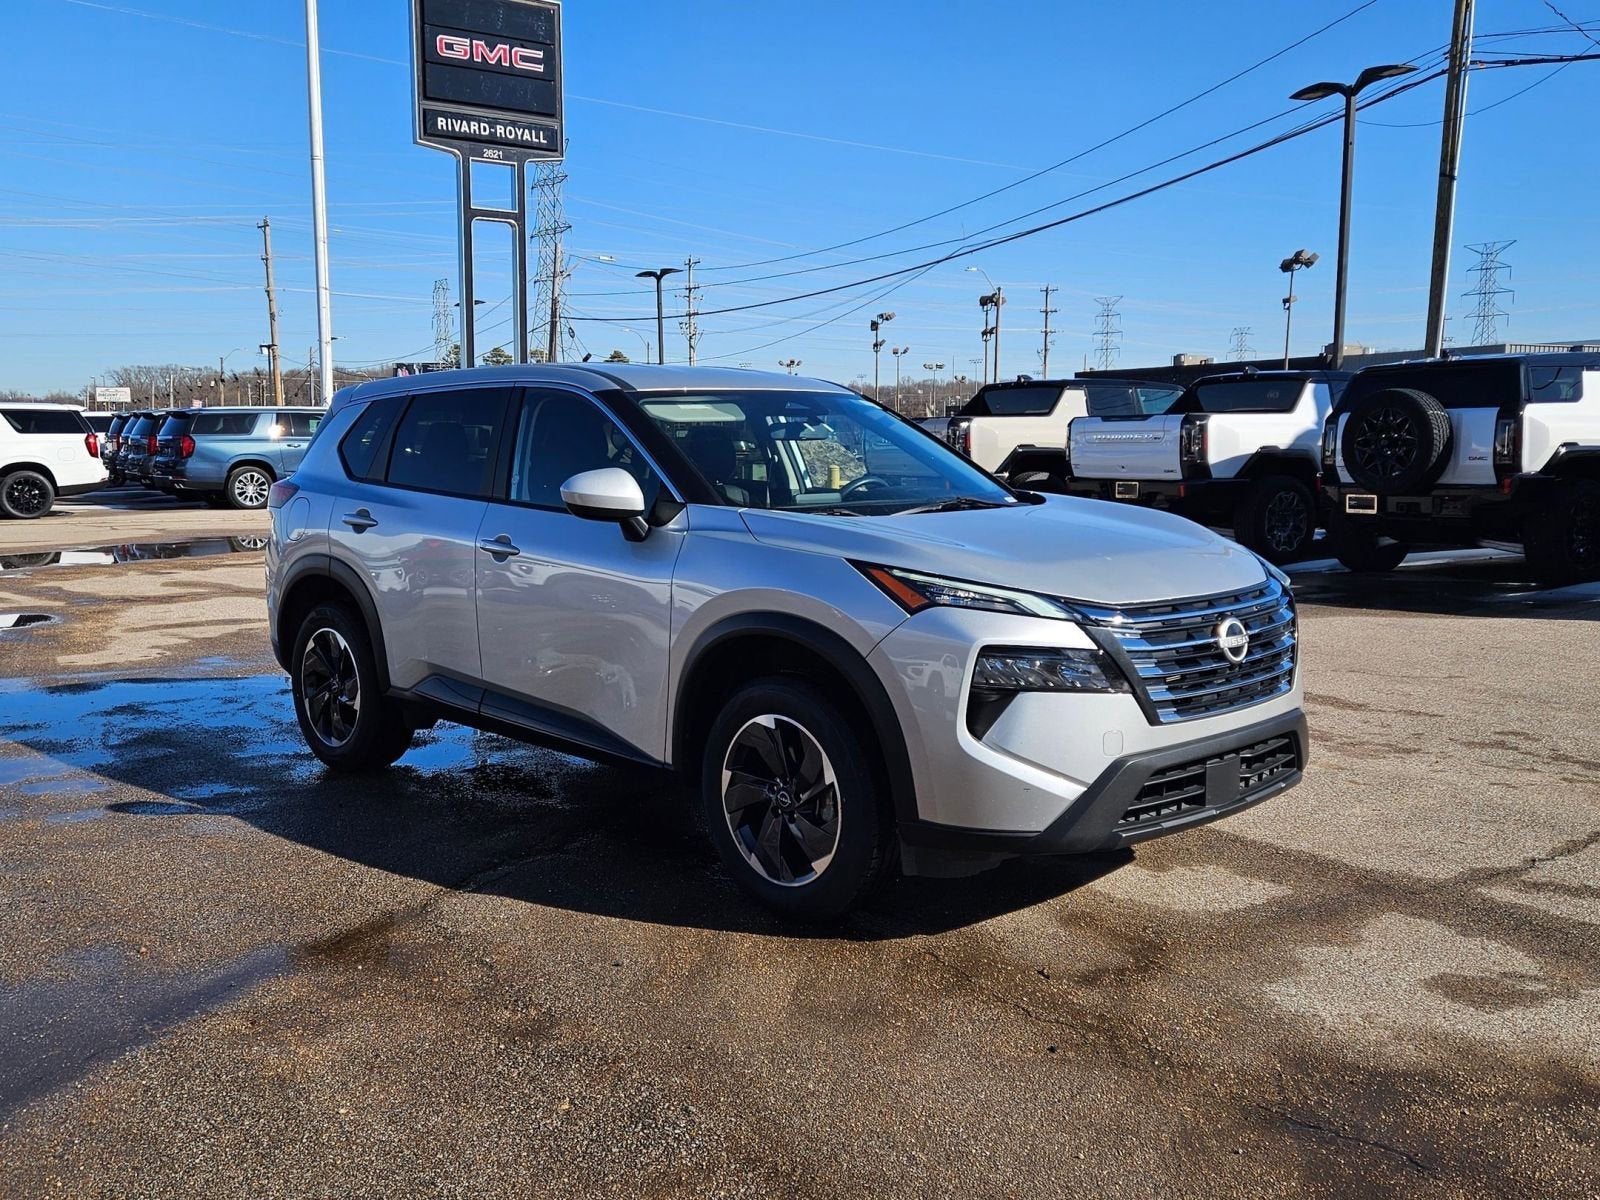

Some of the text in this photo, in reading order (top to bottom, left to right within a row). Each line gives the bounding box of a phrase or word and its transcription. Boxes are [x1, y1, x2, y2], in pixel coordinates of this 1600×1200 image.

[436, 34, 544, 72] GMC
[437, 117, 547, 143] RIVARD-ROYALL
[483, 149, 503, 159] 2621
